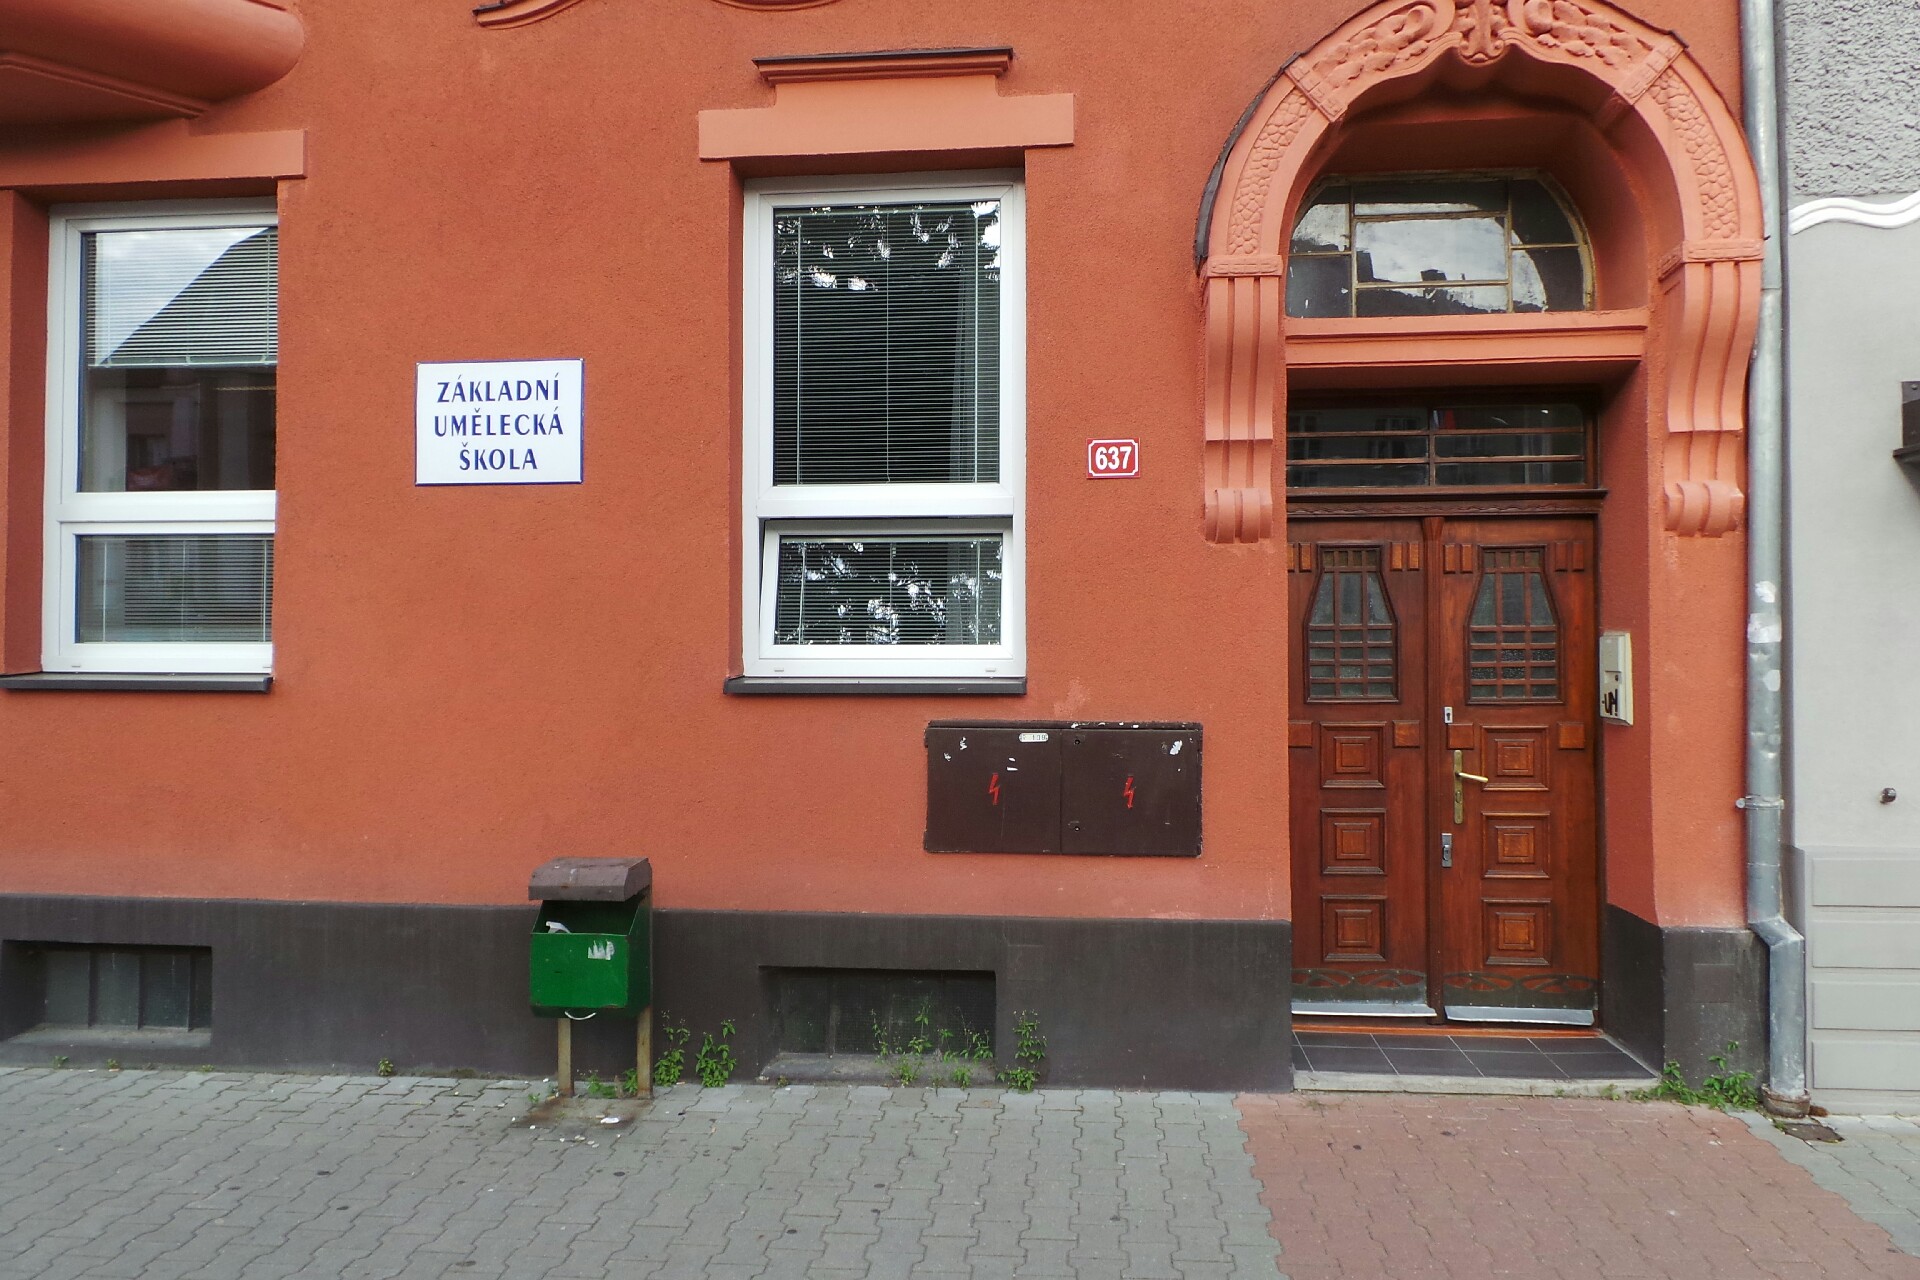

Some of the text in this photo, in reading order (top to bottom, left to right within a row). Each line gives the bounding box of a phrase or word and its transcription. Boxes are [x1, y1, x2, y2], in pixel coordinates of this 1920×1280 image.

[436, 372, 560, 403] ZÁKLADNÍ
[434, 406, 564, 437] UMĚLECKÁ
[459, 442, 538, 471] ŠKOLA
[1095, 446, 1132, 470] 637
